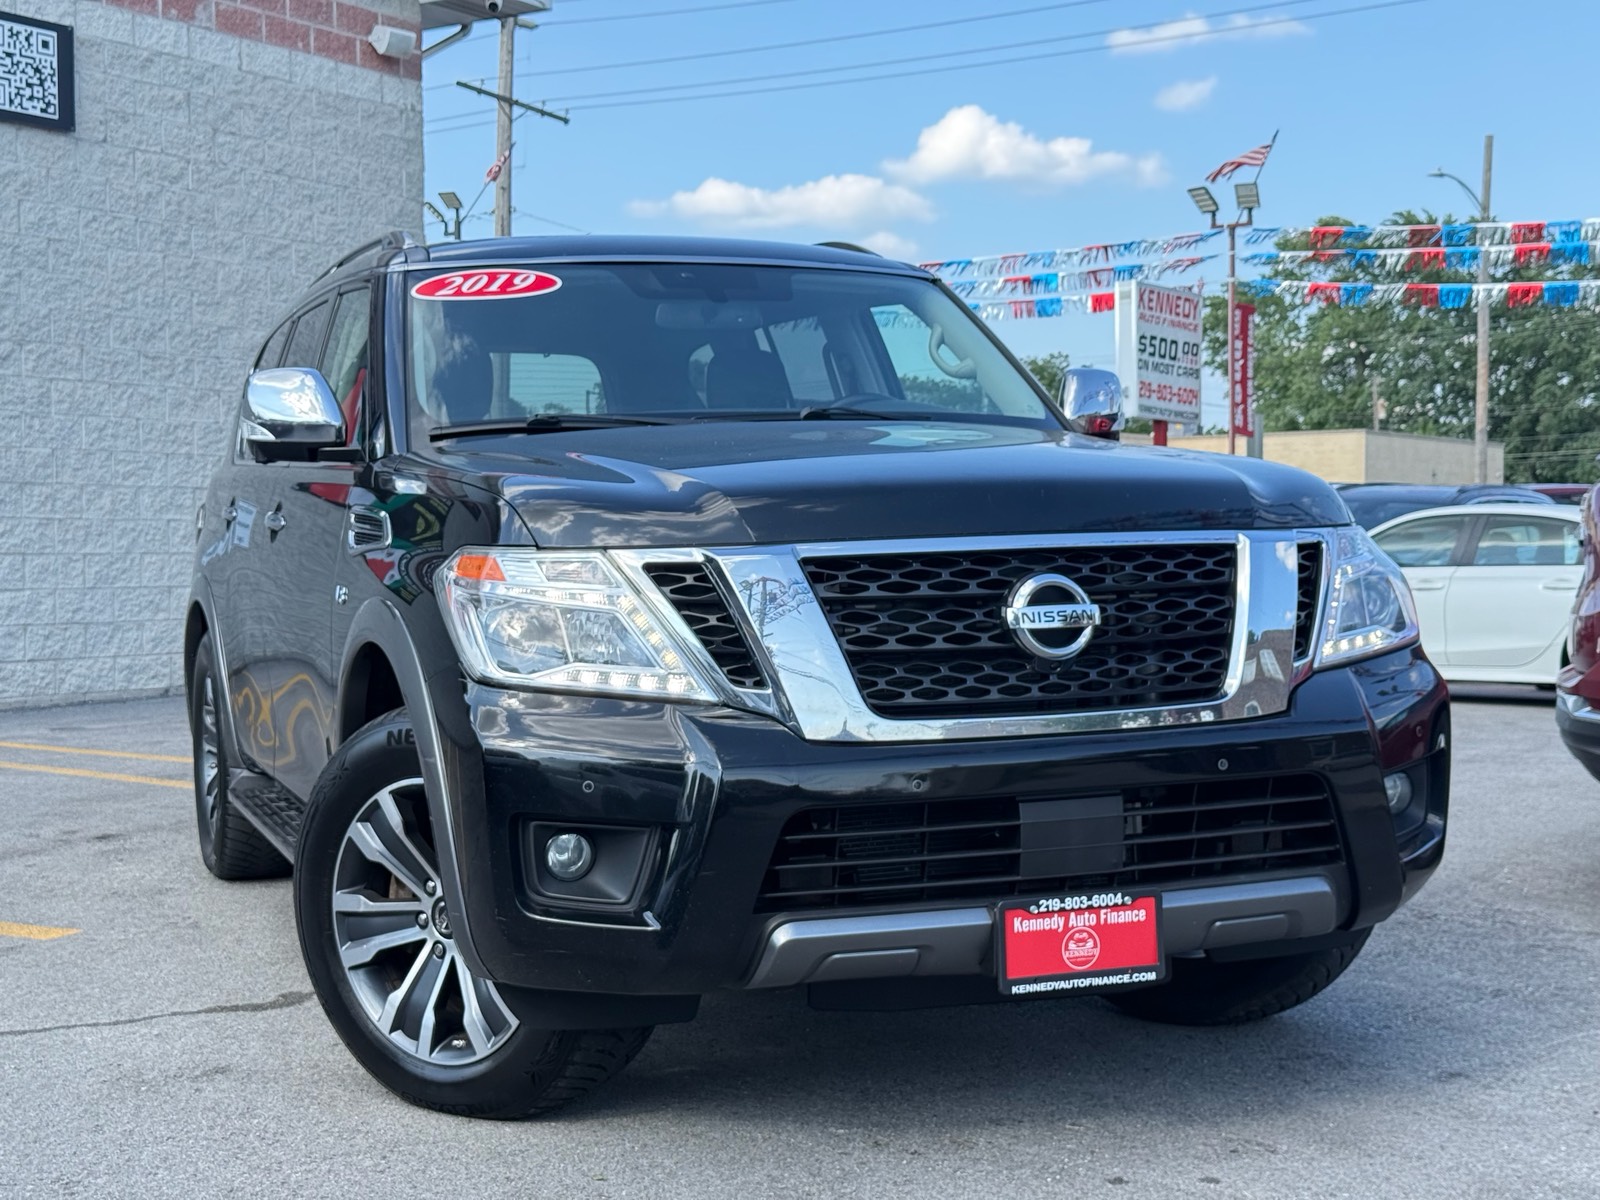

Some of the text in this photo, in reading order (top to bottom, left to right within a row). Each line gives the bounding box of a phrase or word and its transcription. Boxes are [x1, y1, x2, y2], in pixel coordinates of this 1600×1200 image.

[435, 273, 537, 297] 2019
[1138, 287, 1199, 321] KENNEDY
[1139, 311, 1199, 332] AUTO FINANCE
[1138, 358, 1150, 371] ON
[1151, 361, 1175, 376] MOST
[1176, 364, 1200, 379] CARS
[1139, 380, 1198, 407] 219-803-6004
[1021, 608, 1093, 624] NISSAN
[1038, 892, 1123, 913] 219-803-6004
[1013, 908, 1146, 933] Kennedy Auto Finance
[1011, 971, 1157, 995] KENNEDYAUTOFINANCE.COM
